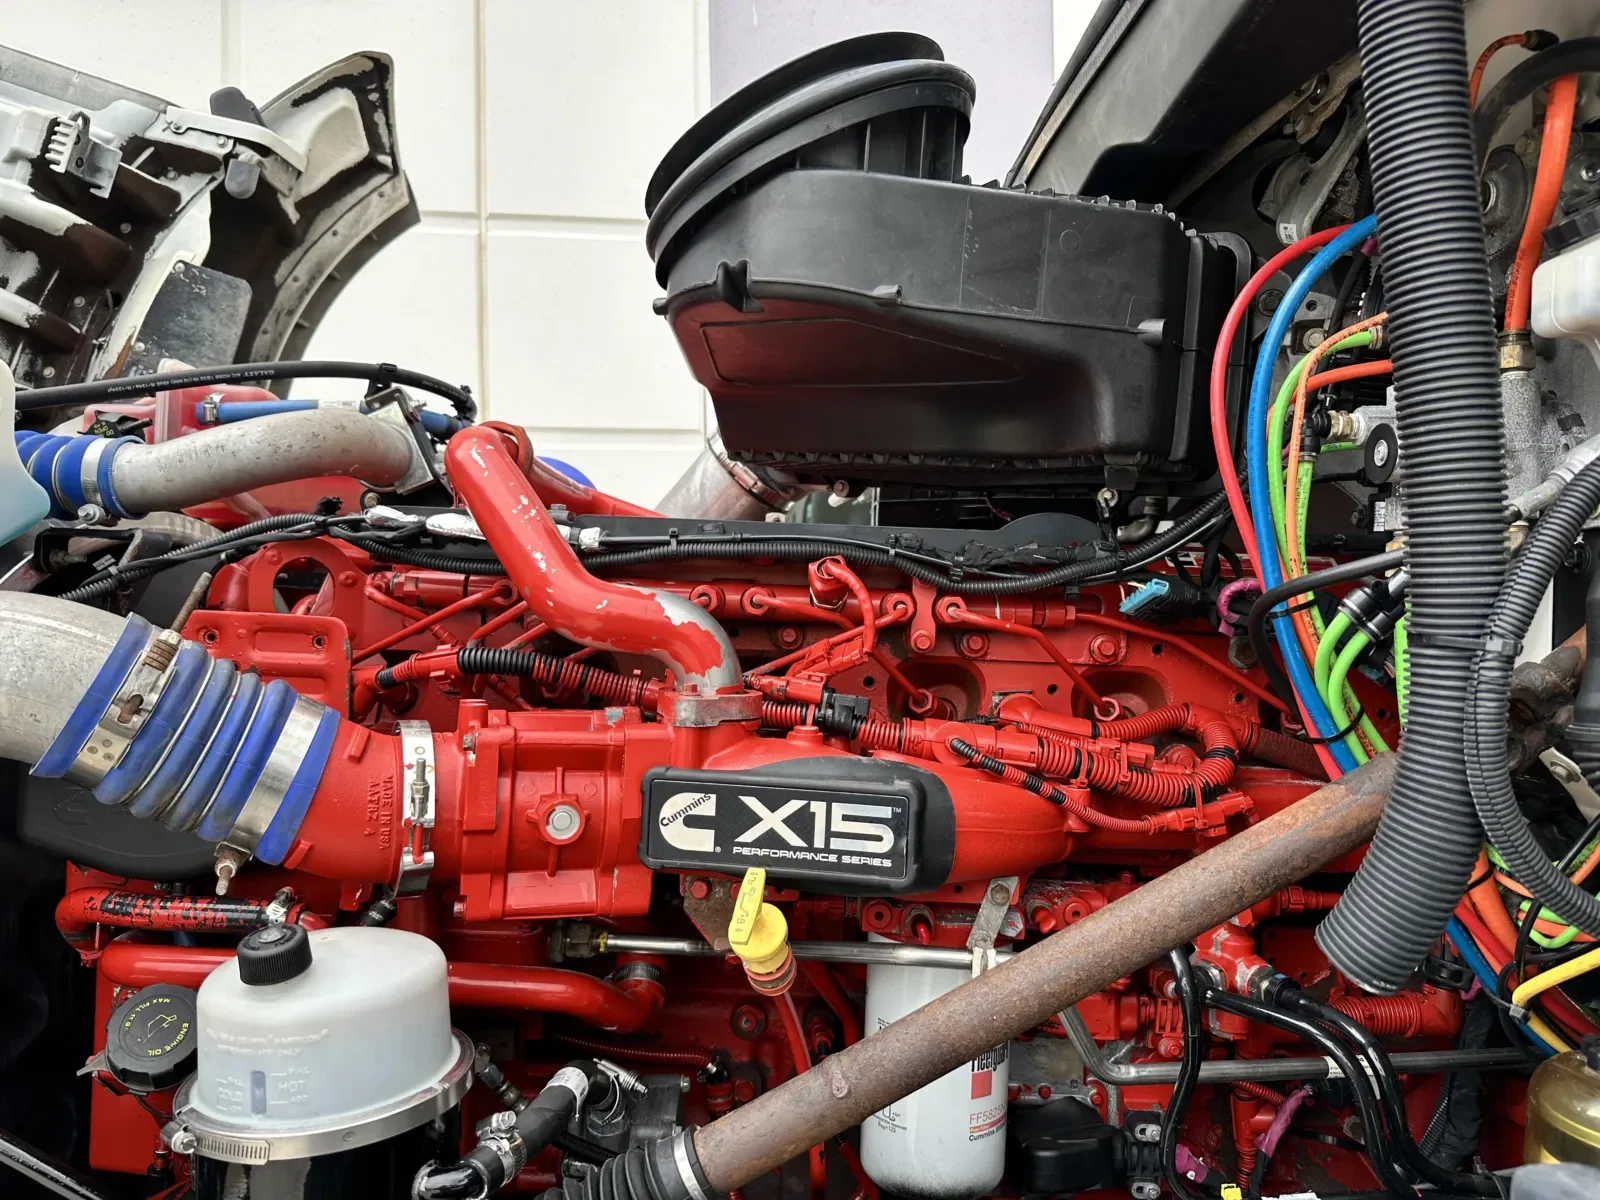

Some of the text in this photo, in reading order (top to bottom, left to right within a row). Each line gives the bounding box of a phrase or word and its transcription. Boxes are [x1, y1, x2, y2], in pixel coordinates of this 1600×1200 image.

[244, 369, 275, 377] GALAXY
[107, 385, 132, 393] R-1234yf
[379, 775, 394, 851] MADE IN USA
[659, 793, 712, 828] Cummins
[732, 846, 892, 868] PERFORMANCE SERIES
[135, 1001, 151, 1012] FILL
[164, 1022, 189, 1052] ENGINE
[147, 1048, 162, 1056] OIL
[278, 1047, 302, 1057] ONLY
[287, 1066, 311, 1075] FULL
[278, 1080, 308, 1093] HOT
[218, 1086, 243, 1102] COLD
[968, 1129, 995, 1142] Cummins
